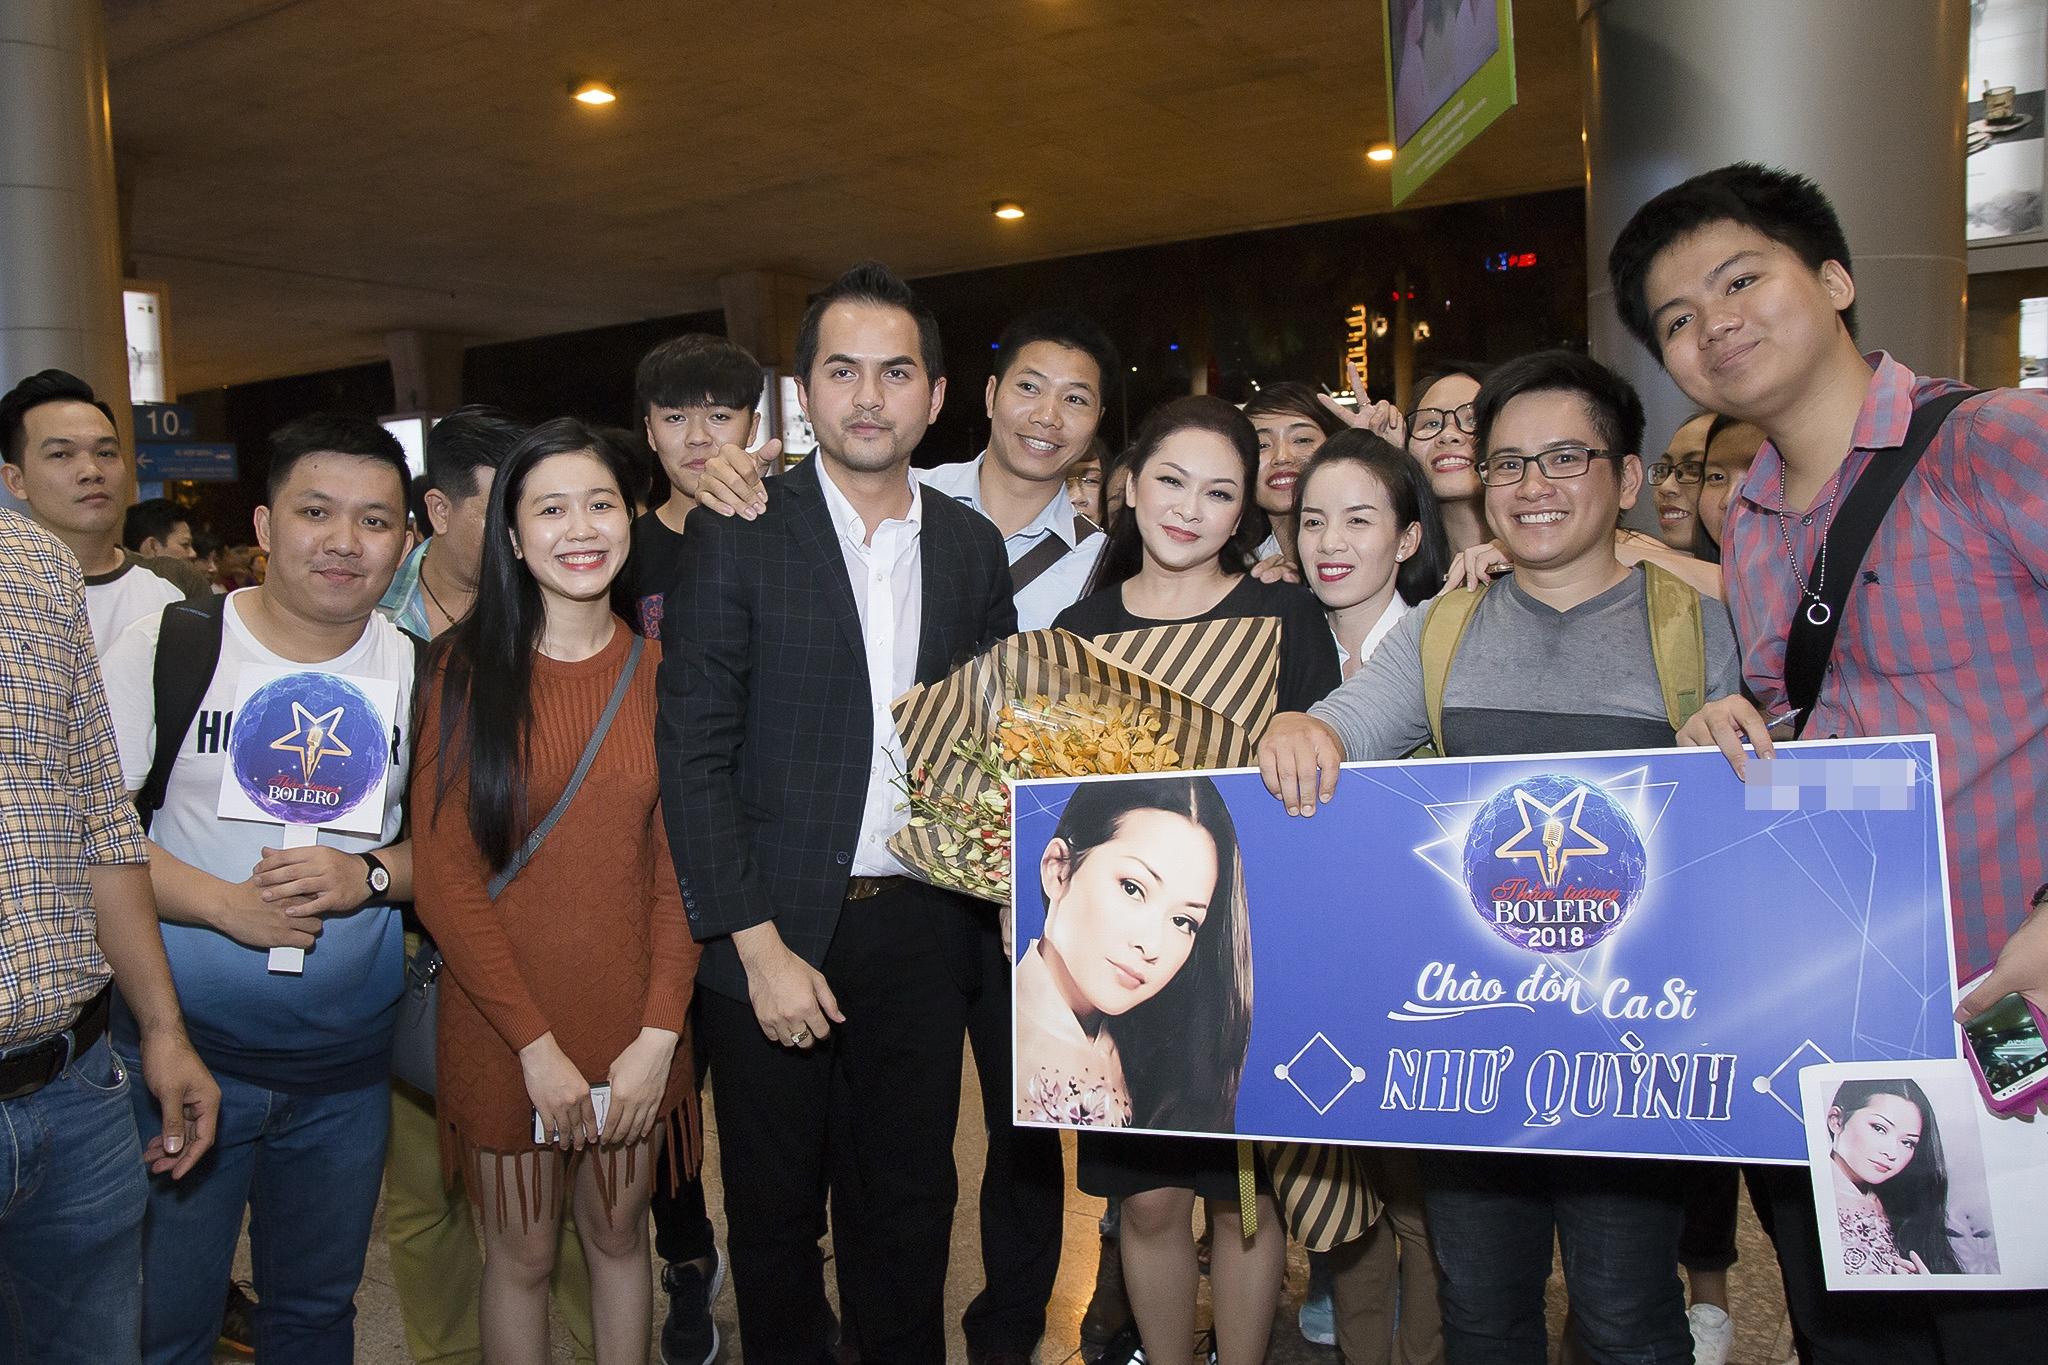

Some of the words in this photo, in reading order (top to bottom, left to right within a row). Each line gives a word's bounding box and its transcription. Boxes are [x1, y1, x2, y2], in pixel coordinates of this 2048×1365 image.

[146, 410, 180, 436] 10
[267, 784, 340, 807] BOLERO
[1491, 898, 1622, 925] BOLERO
[1527, 926, 1586, 947] 2018
[1416, 961, 1506, 1003] Chào
[1602, 977, 1652, 1020] Ca
[1654, 977, 1698, 1020] Sĩ
[1380, 1045, 1515, 1115] NHƯ
[1523, 1030, 1738, 1128] QUỲNH
